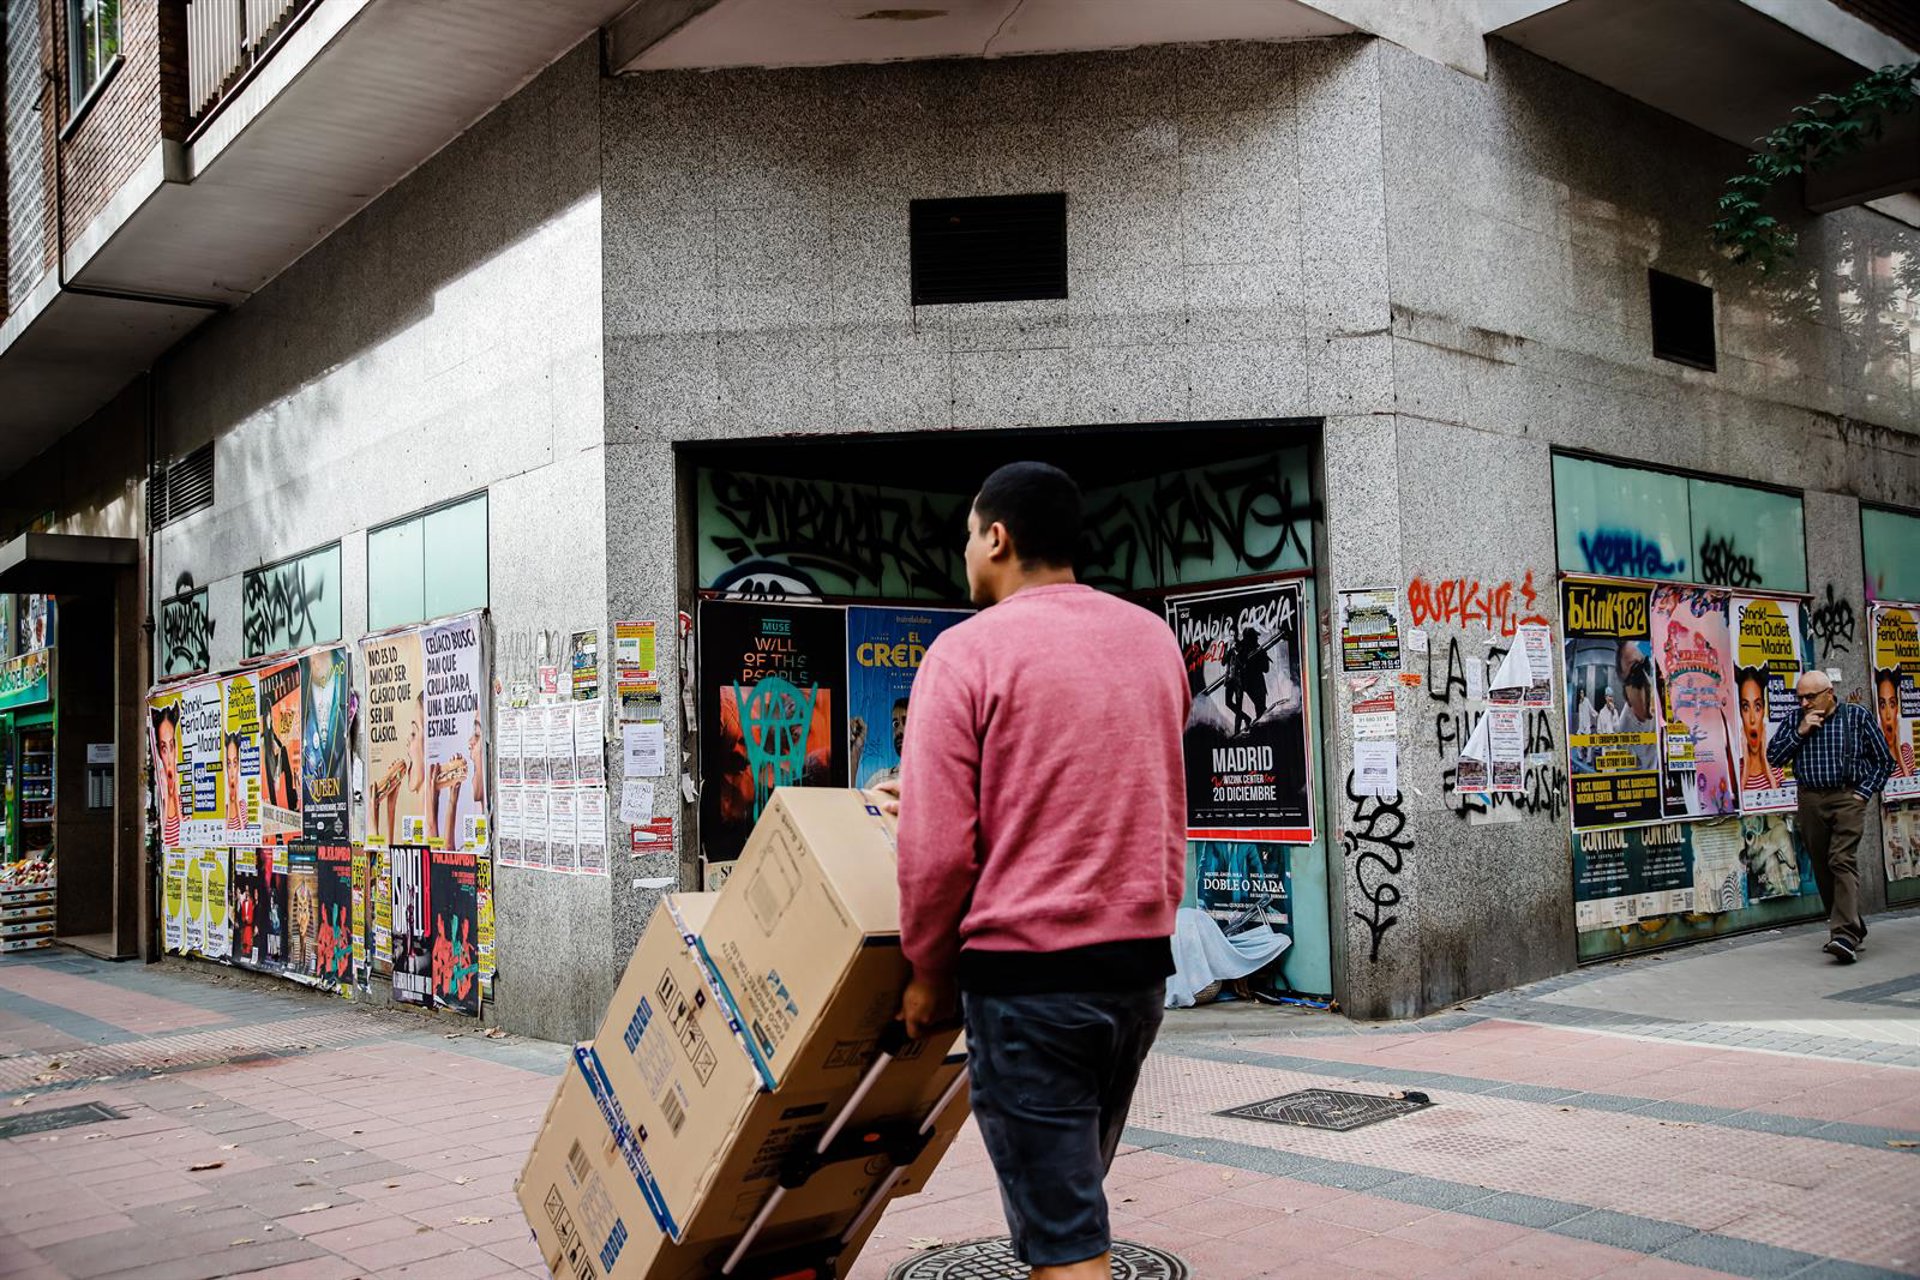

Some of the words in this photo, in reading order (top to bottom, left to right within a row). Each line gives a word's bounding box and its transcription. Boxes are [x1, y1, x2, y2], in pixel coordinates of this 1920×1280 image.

[1738, 605, 1767, 620] Stock!
[762, 622, 790, 632] MUSE
[1740, 620, 1763, 637] Feria
[1764, 623, 1790, 639] Outlet
[1877, 626, 1896, 643] Feria
[1896, 629, 1920, 643] Outlet
[425, 634, 451, 656] CELÍACO
[754, 637, 798, 652] WILL
[908, 631, 921, 643] EL
[1761, 638, 1792, 655] Madrid
[368, 649, 381, 667] NO
[382, 646, 389, 663] ES
[390, 645, 398, 661] LO
[1894, 642, 1920, 657] Madrid
[427, 657, 441, 676] PAN
[442, 653, 457, 673] QUE
[744, 653, 766, 667] OF
[771, 655, 808, 669] THE
[370, 666, 393, 686] MISMO
[395, 664, 407, 682] SER
[427, 676, 450, 696] CRUJA
[451, 672, 471, 691] PARA
[370, 683, 396, 705] CLÁSICO
[397, 681, 411, 702] QUE
[427, 697, 443, 717] UNA
[444, 690, 478, 715] RELACIÓN
[181, 713, 200, 736] Feria
[199, 709, 221, 731] Outlet
[371, 709, 383, 725] SER
[384, 706, 394, 723] UN
[371, 724, 398, 743] CLÁSICO.
[428, 718, 458, 738] ESTABLE.
[198, 732, 222, 753] Madrid
[1212, 746, 1273, 773] MADRID
[1213, 787, 1226, 802] 20
[1227, 785, 1277, 802] DICIEMBRE
[1203, 878, 1241, 891] DOBLE
[1242, 879, 1251, 892] O
[1252, 880, 1286, 893] NADA
